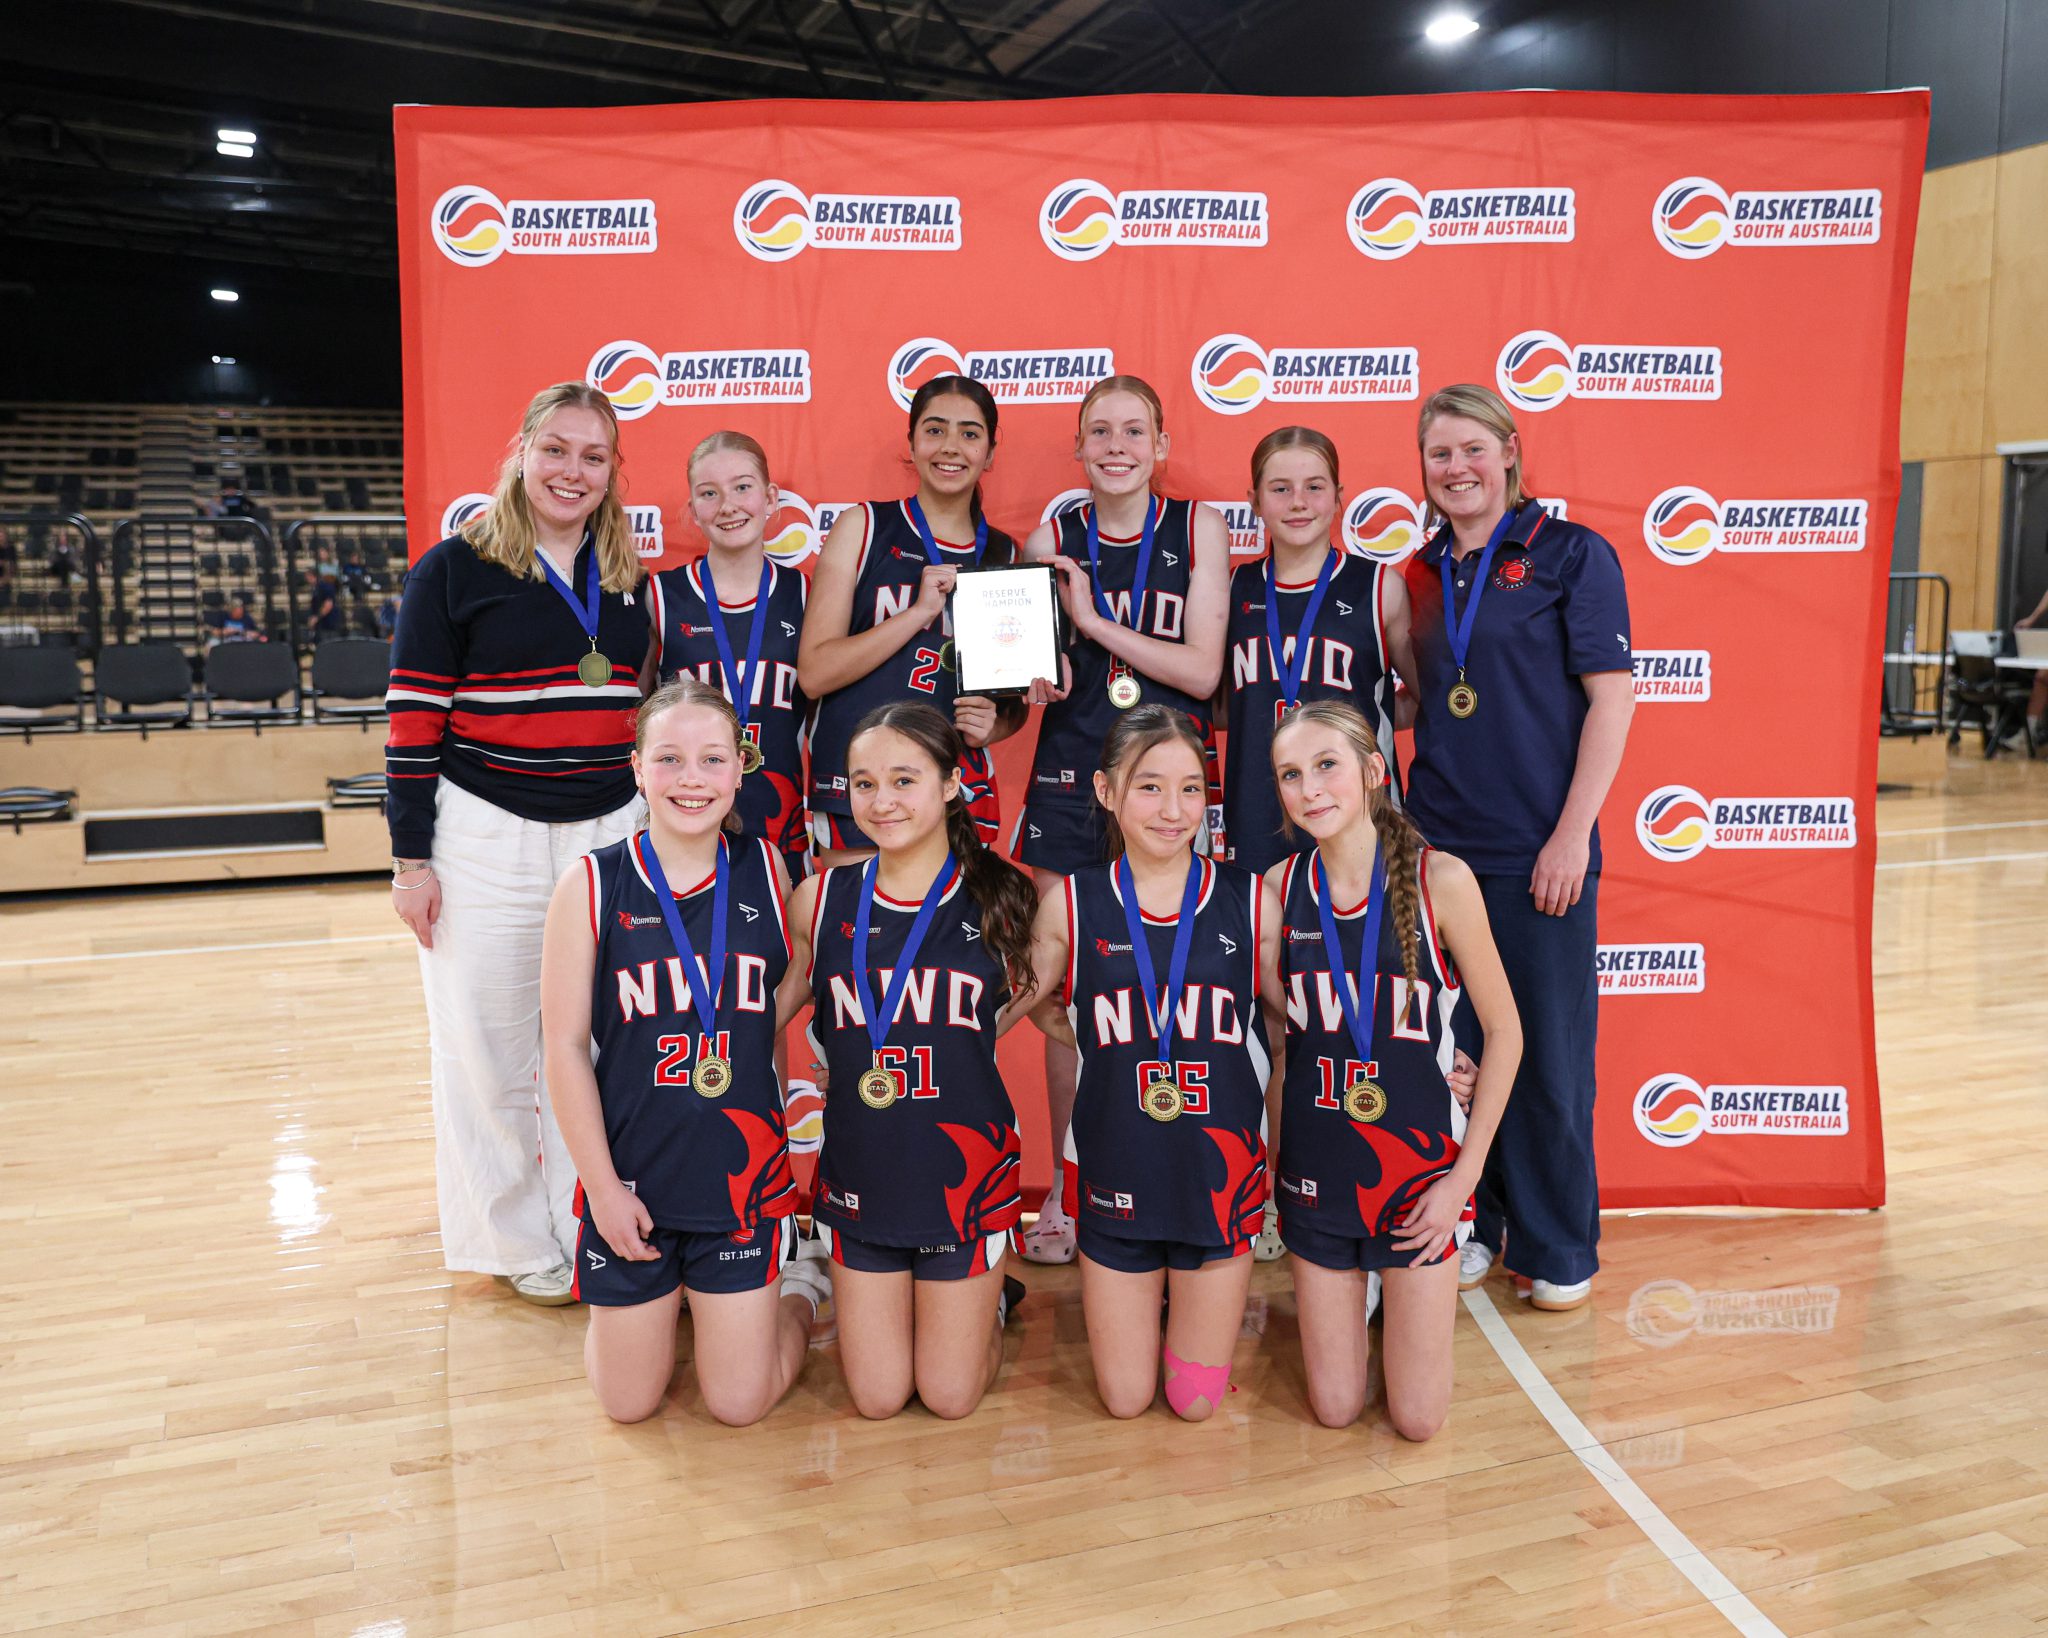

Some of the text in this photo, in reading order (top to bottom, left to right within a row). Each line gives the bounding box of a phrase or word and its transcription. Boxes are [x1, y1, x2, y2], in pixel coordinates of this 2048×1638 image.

[815, 201, 954, 225] BASKETBALL
[1121, 198, 1261, 221] BASKETBALL
[1428, 195, 1568, 219] BASKETBALL
[1734, 196, 1874, 220] BASKETBALL
[511, 206, 649, 229] BASKETBALL
[815, 226, 955, 243] SOUTH AUSTRALIA
[1121, 223, 1261, 239] SOUTH AUSTRALIA
[1428, 220, 1567, 237] SOUTH AUSTRALIA
[1733, 222, 1873, 238] SOUTH AUSTRALIA
[511, 231, 650, 247] SOUTH AUSTRALIA
[666, 356, 803, 381] BASKETBALL
[969, 355, 1107, 379] BASKETBALL
[1272, 354, 1412, 377] BASKETBALL
[1577, 352, 1715, 375] BASKETBALL
[666, 381, 804, 398] SOUTH AUSTRALIA
[1024, 380, 1099, 396] AUSTRAL
[1272, 379, 1412, 395] SOUTH AUSTRALIA
[1576, 377, 1715, 393] SOUTH AUSTRALIA
[1724, 506, 1860, 528] BASKETBALL
[1722, 530, 1858, 545] SOUTH AUSTRALIA
[982, 587, 1027, 598] RESERVE
[984, 597, 1032, 608] HAMPION
[908, 646, 941, 695] 2
[1632, 657, 1703, 678] ETBALL
[1633, 681, 1703, 695] USTRALIA
[1714, 804, 1848, 825] BASKETBALL
[1714, 827, 1849, 841] SOUTH AUSTRALIA
[1596, 950, 1698, 971] SKETBALL
[1618, 973, 1698, 988] AUSTRALIA
[828, 967, 984, 1033] NWD
[1093, 983, 1243, 1049] NWD
[701, 1073, 724, 1083] STATE
[872, 1045, 940, 1100] 61
[867, 1085, 889, 1093] STATE
[1136, 1060, 1211, 1115] 65
[1152, 1098, 1175, 1106] STATE
[1354, 1098, 1378, 1107] STATE
[1710, 1091, 1841, 1112] BASKETBALL
[1711, 1114, 1842, 1129] SOUTH AUSTRALIA
[720, 1247, 761, 1260] EST.1946
